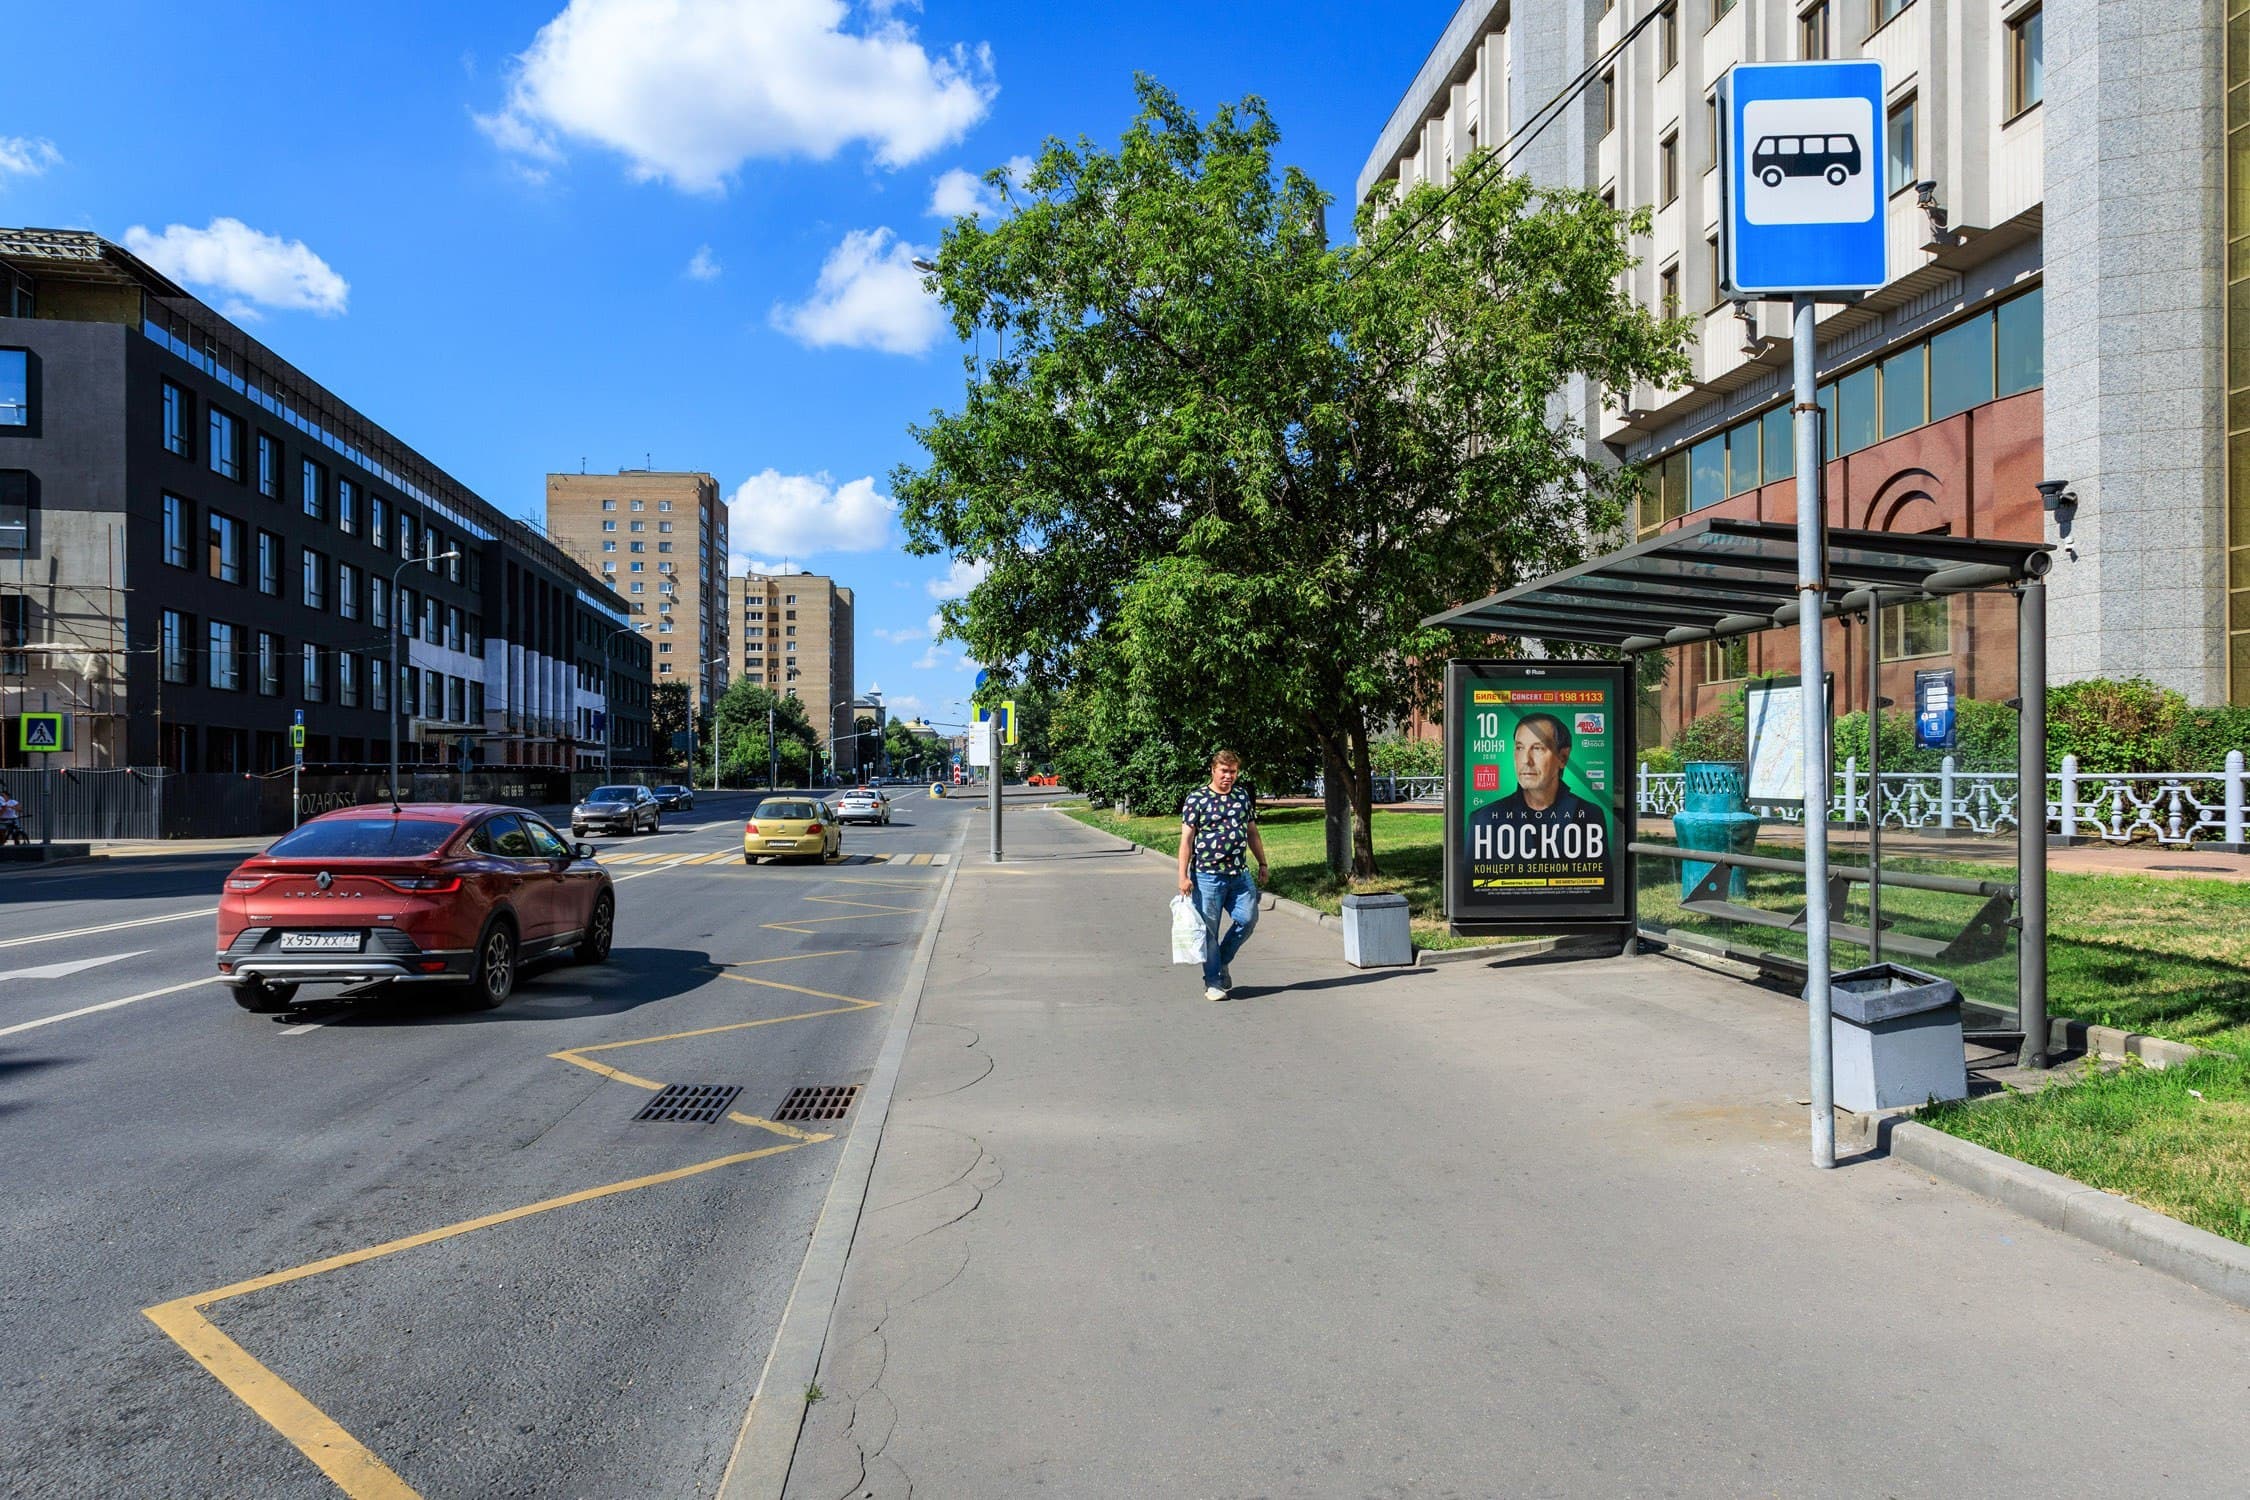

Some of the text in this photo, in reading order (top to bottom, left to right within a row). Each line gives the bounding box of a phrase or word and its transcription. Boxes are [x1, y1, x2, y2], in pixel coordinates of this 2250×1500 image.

[1475, 692, 1510, 700] БИЛЕТЫ
[1511, 692, 1542, 701] CONCERT
[1559, 692, 1577, 701] 198
[1579, 692, 1603, 701] 1133
[1476, 713, 1498, 738] 10
[1473, 740, 1505, 752] ИЮНЯ
[1491, 810, 1586, 819] НИКОЛАЙ
[1474, 823, 1604, 860] НОСКОВ
[1474, 862, 1604, 874] КОНЦЕРТ В ЗЕЛЕНОМ ТЕАТРЕ
